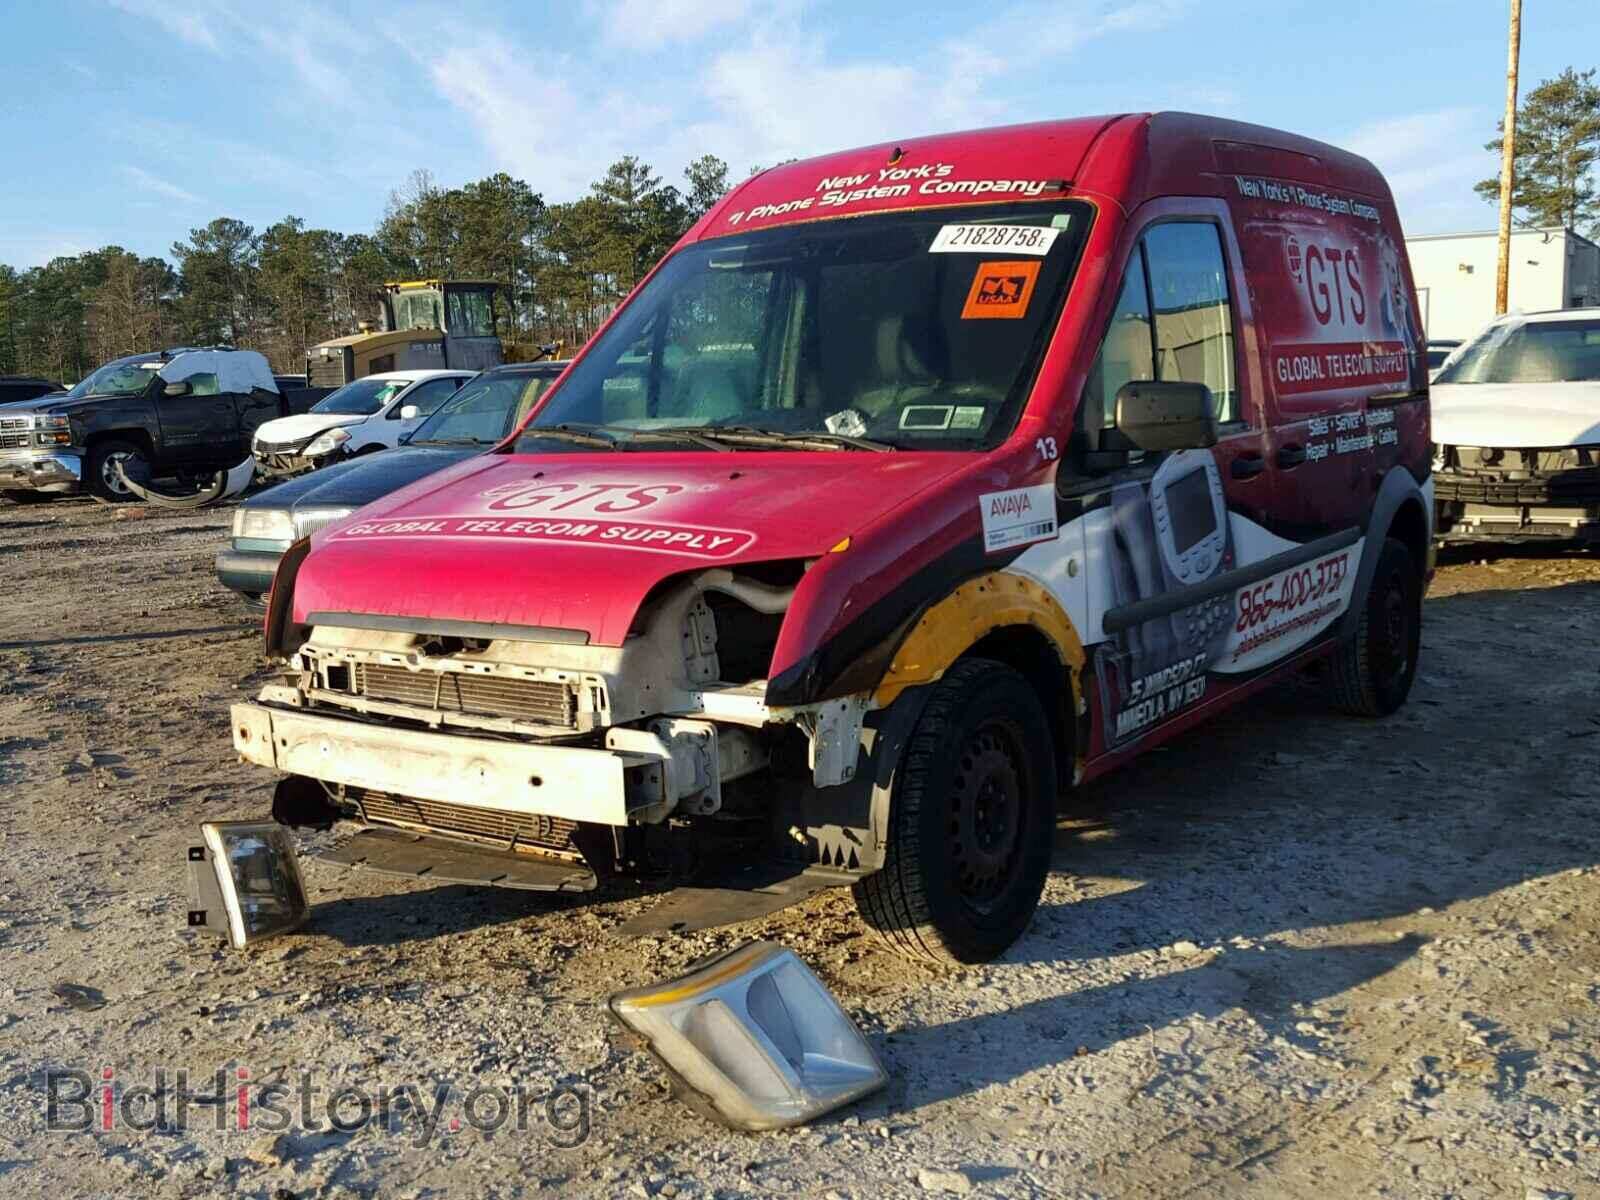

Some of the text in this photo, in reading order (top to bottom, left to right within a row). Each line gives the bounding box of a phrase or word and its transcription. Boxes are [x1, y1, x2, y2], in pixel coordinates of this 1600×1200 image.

[816, 163, 954, 192] New York's
[1234, 175, 1260, 198] New
[1298, 187, 1323, 210] Phone
[745, 197, 815, 222] Phone
[818, 183, 912, 207] System
[919, 179, 1046, 196] Company
[978, 294, 1014, 304] USAA
[1305, 243, 1366, 326] GTS
[1276, 350, 1406, 382] GLOBAL TELECOM SUPPLY
[1036, 436, 1059, 460] 13
[1305, 440, 1329, 463] Repair
[487, 482, 686, 513] GTS
[991, 493, 1033, 519] AVAYA
[346, 520, 734, 550] GLOBAL TELECOM SUPPLY
